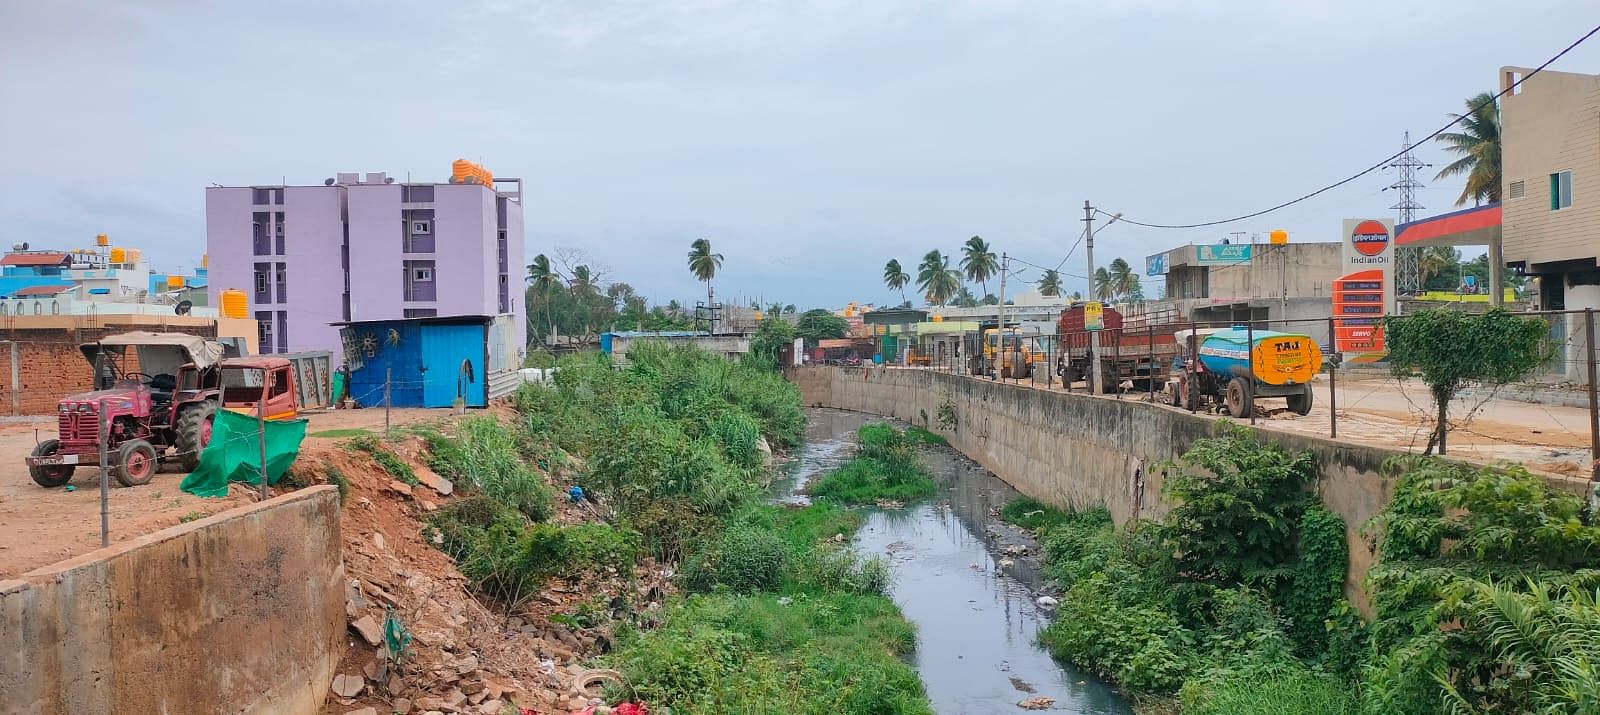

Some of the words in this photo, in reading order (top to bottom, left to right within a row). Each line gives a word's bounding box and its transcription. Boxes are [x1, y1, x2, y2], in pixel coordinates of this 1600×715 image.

[1351, 256, 1389, 264] IndianOil
[1351, 330, 1371, 338] SERVO
[1275, 341, 1299, 352] TAJ
